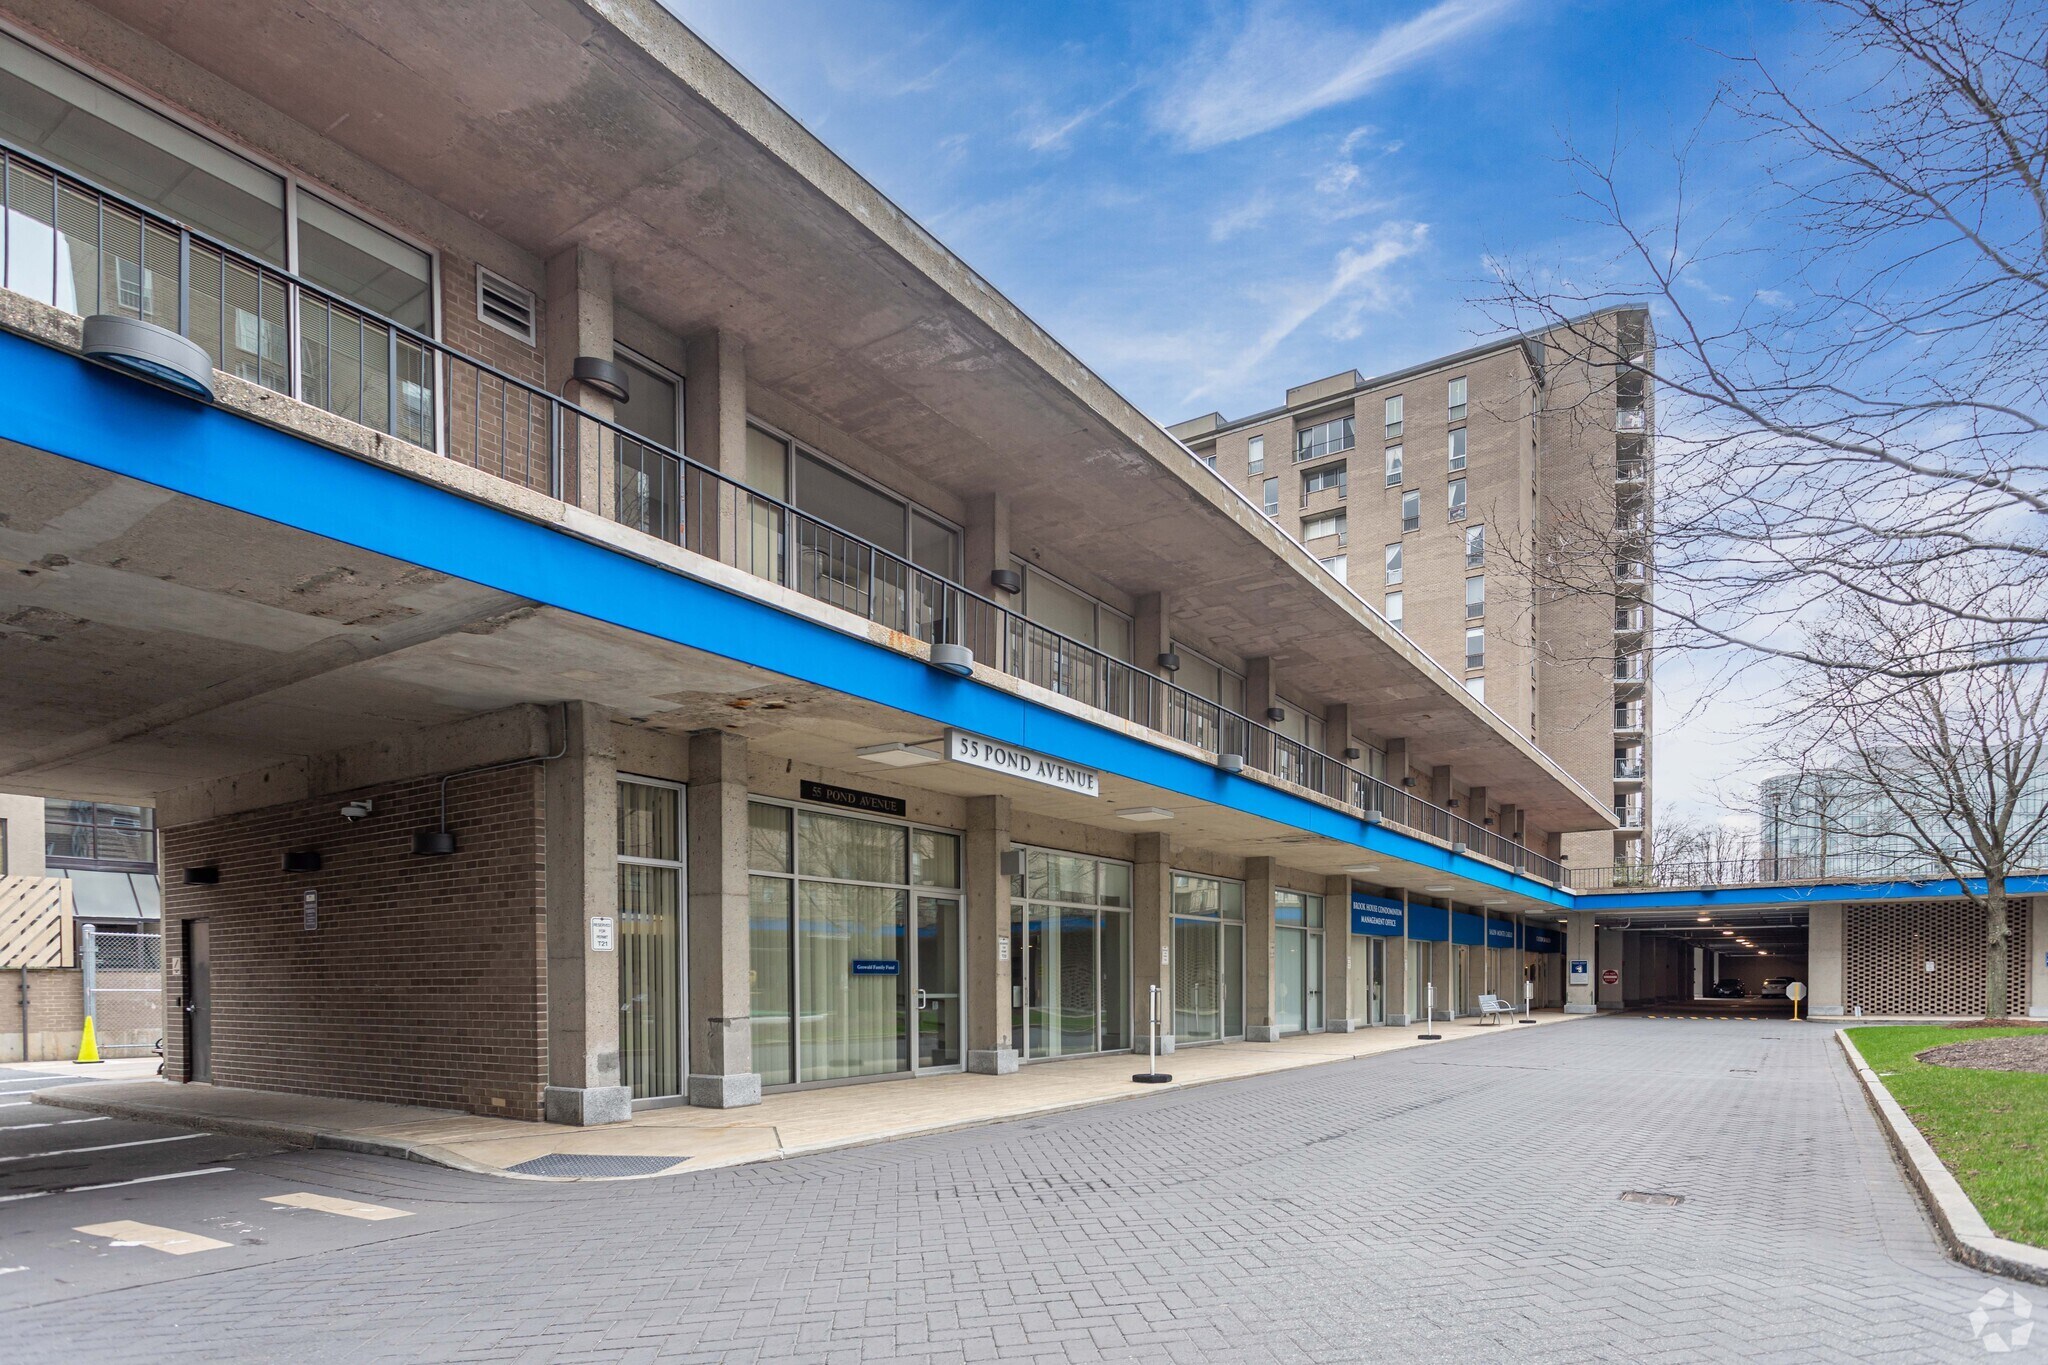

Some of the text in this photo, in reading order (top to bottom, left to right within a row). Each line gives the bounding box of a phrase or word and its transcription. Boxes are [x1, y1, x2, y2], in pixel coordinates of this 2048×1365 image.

[960, 737, 1094, 790] 55 POND AVENUE
[811, 786, 897, 811] 55 POND AVENUE
[1353, 901, 1366, 910] BROOK
[1366, 903, 1378, 913] HOUSE
[1361, 915, 1396, 927] MANAGEMENT OFFICE
